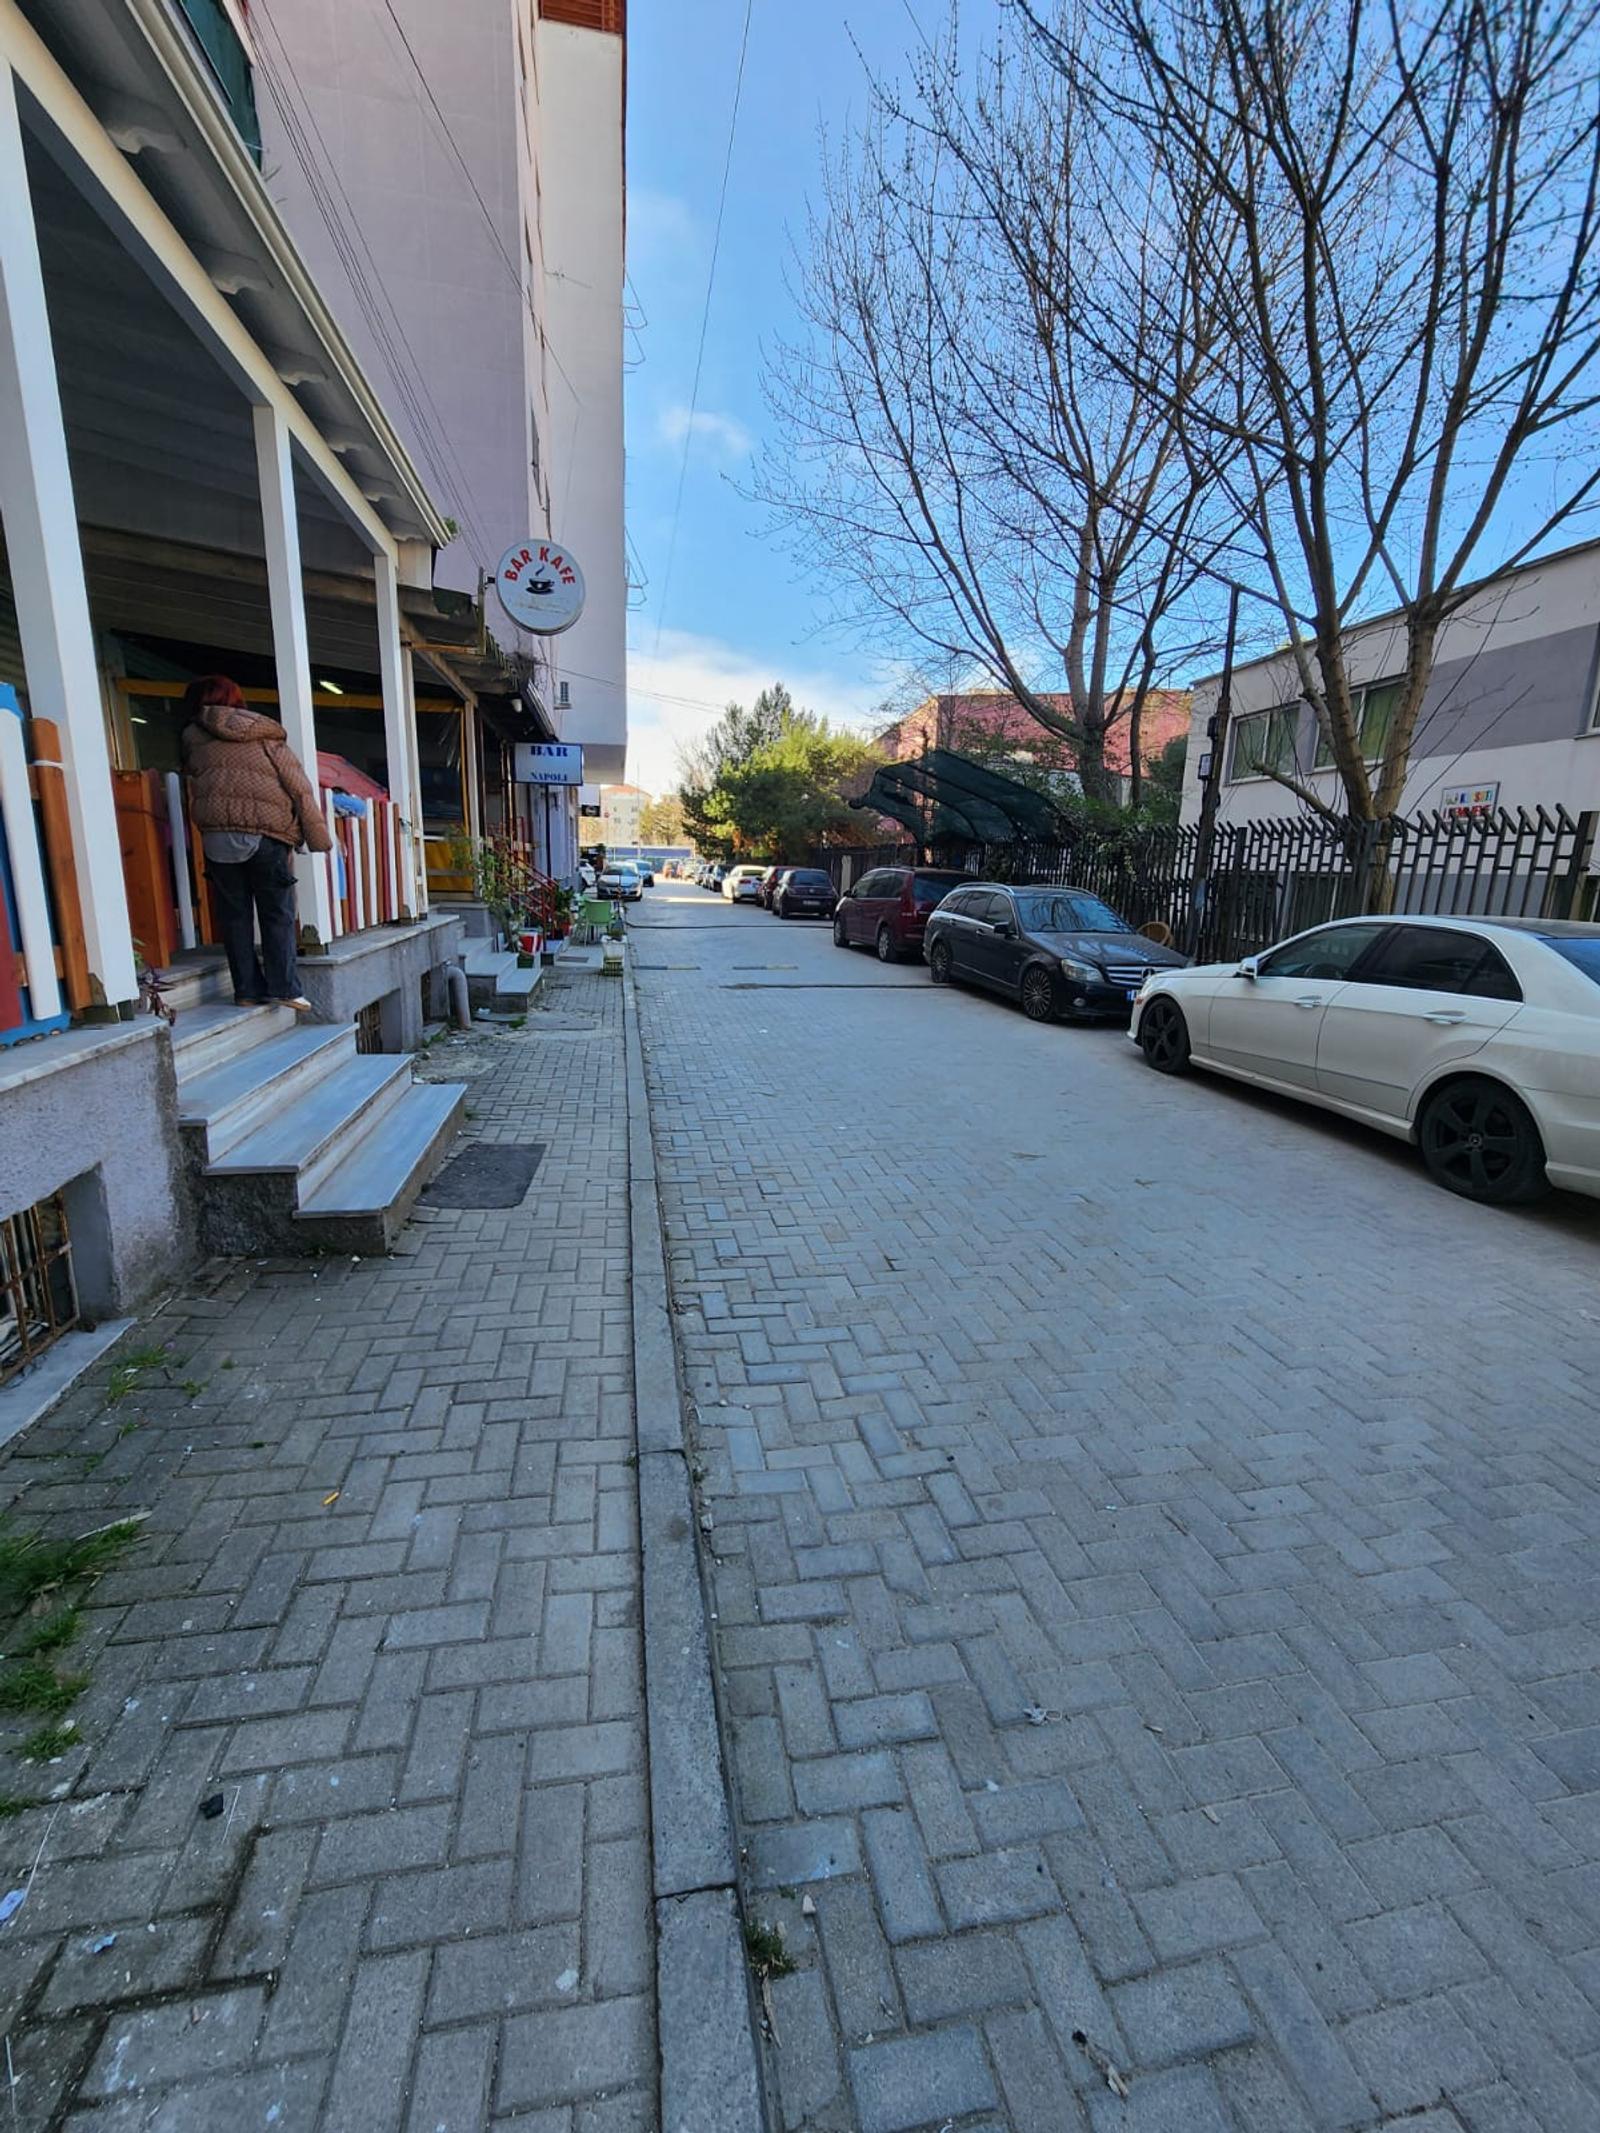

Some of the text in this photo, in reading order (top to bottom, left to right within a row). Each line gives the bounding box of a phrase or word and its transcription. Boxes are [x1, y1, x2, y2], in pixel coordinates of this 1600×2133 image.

[504, 546, 576, 585] BAR KAFE
[530, 745, 569, 758] BAR
[530, 771, 569, 783] NAPOLI
